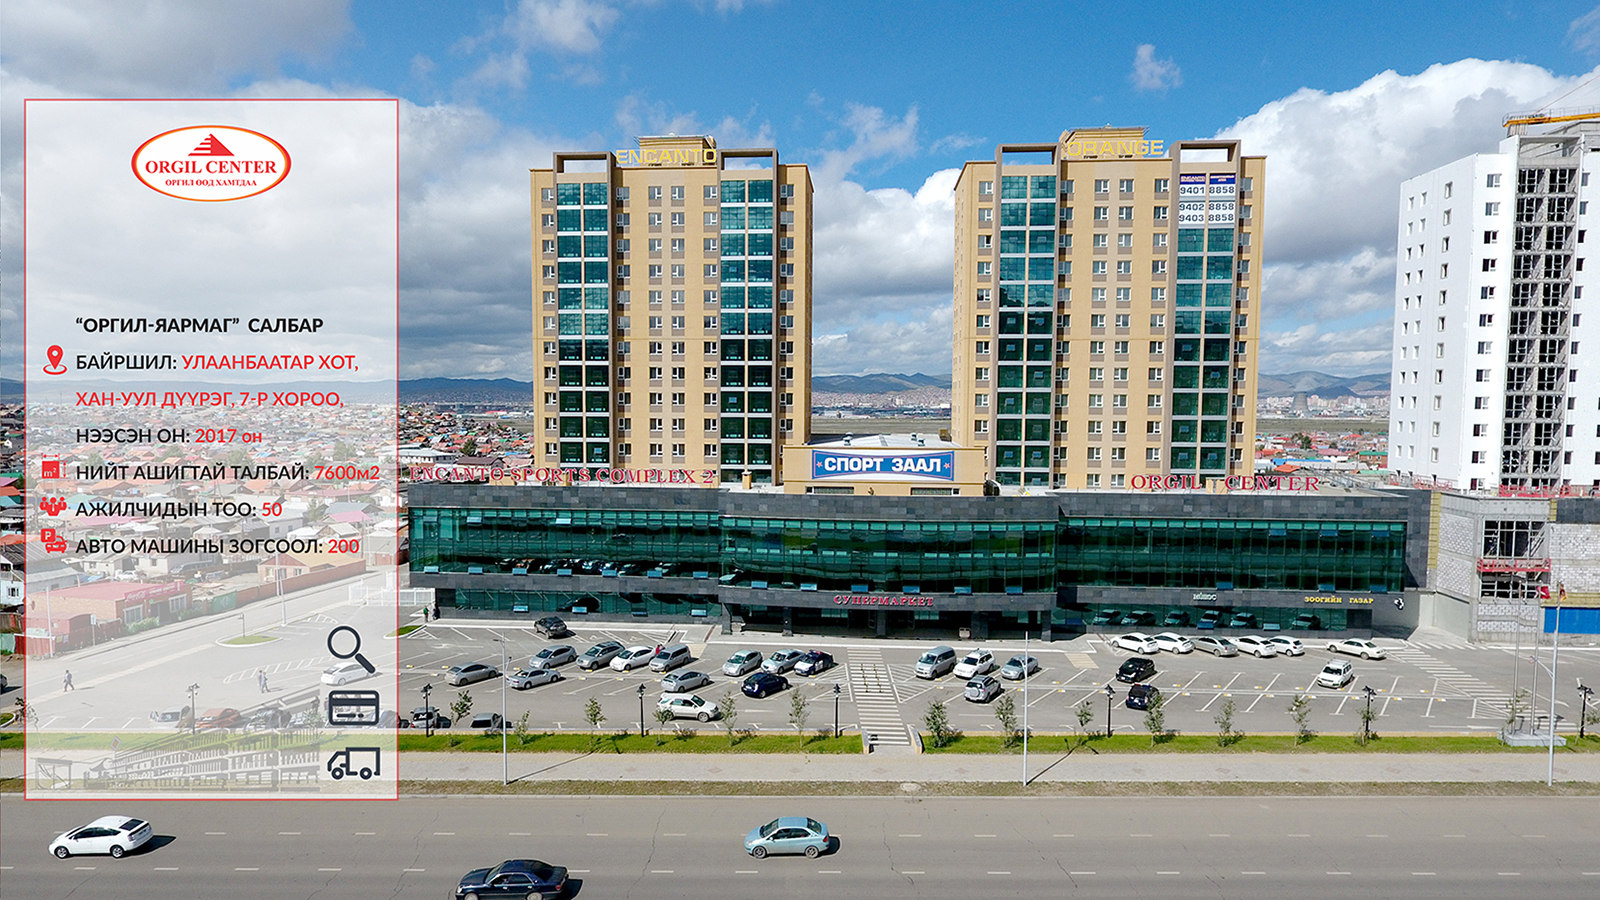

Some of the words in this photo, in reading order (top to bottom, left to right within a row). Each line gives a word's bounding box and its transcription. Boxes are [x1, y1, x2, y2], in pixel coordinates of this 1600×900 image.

[1068, 140, 1164, 156] ORANGE
[616, 149, 716, 163] ENCANTO
[1210, 186, 1234, 194] 8858
[1179, 214, 1204, 222] 9403
[824, 458, 883, 472] СПОРТ
[892, 458, 941, 472] ЗААЛ
[410, 466, 504, 482] ENCANTO
[511, 467, 590, 482] SPORTS
[596, 468, 696, 483] COMPLEX
[704, 470, 714, 483] 2
[1131, 475, 1202, 489] ORGIL
[1225, 475, 1319, 491] CENTER
[834, 595, 934, 606] СУПЕРМАРКЕТ
[1304, 595, 1342, 603] ЗООГИЙН
